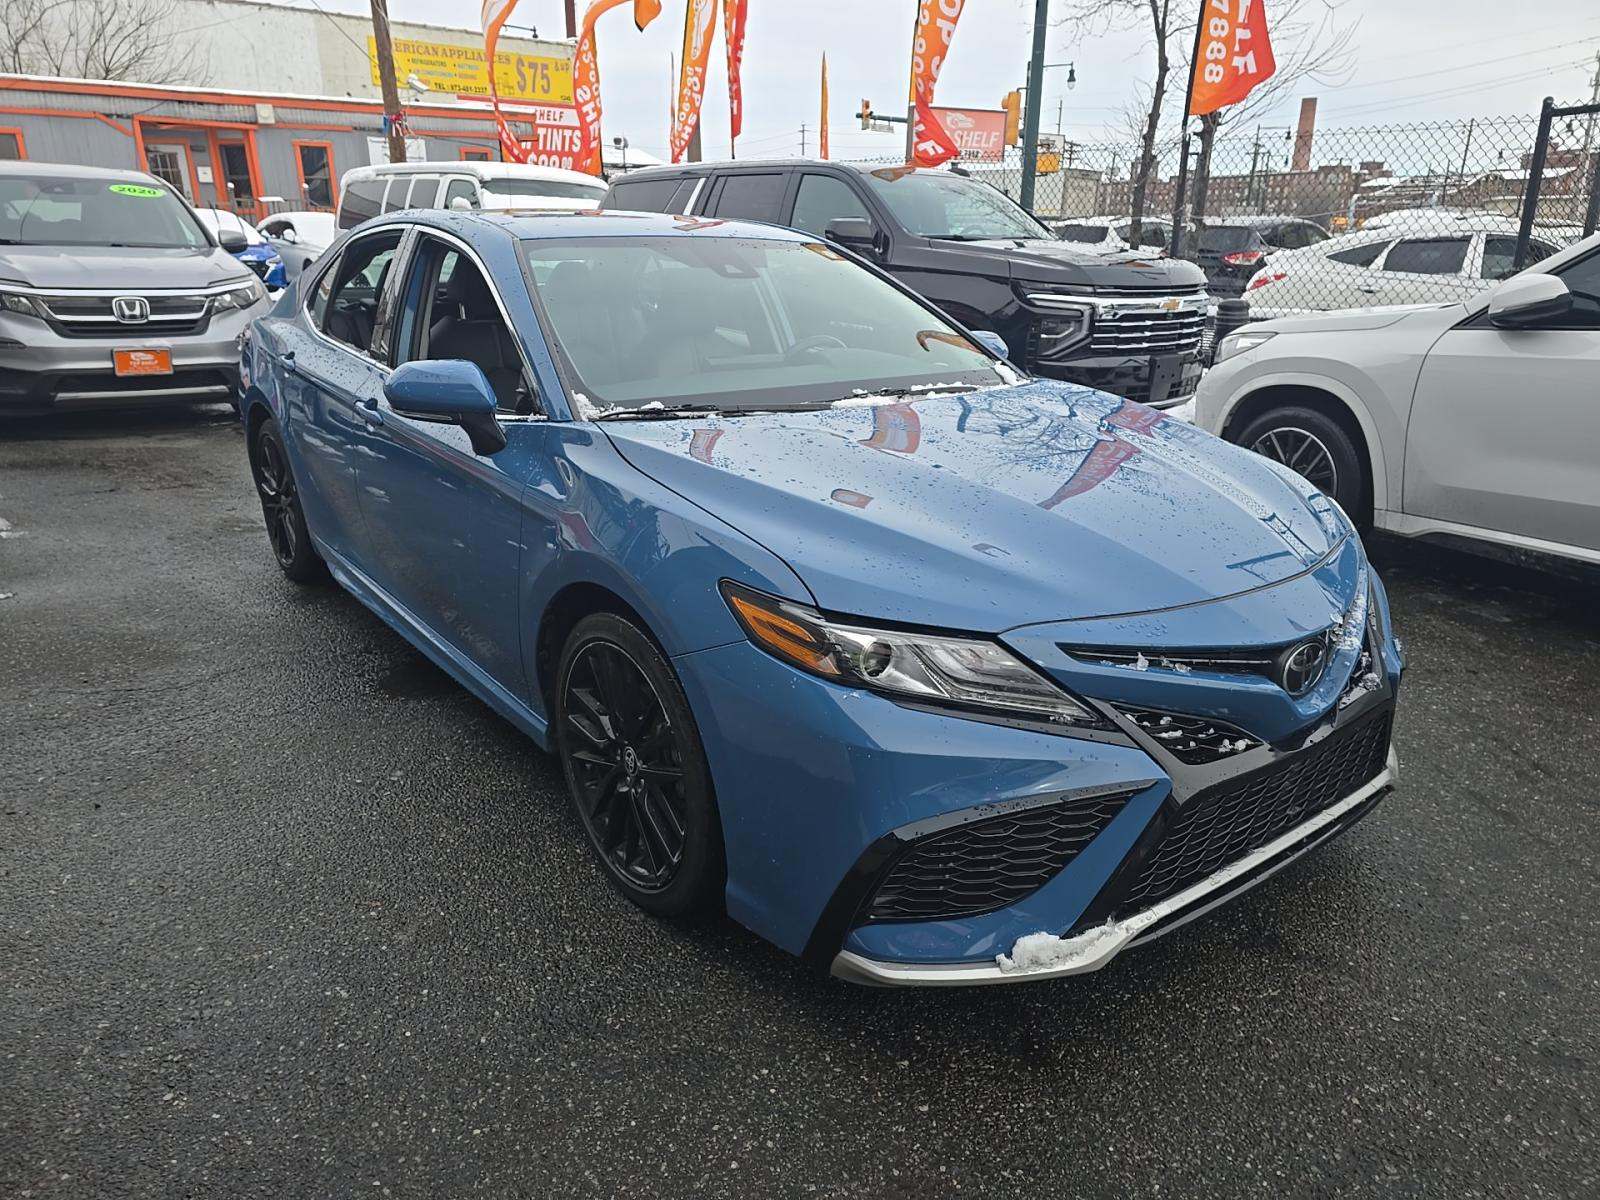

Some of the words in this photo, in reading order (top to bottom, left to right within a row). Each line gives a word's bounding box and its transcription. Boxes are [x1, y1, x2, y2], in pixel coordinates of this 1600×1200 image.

[394, 41, 439, 57] ERICAN
[441, 47, 511, 64] APPLIAES
[516, 56, 551, 95] $75
[536, 109, 564, 121] HELF
[537, 127, 582, 152] TINTS
[953, 130, 1000, 149] SHELF
[117, 186, 157, 195] 2020
